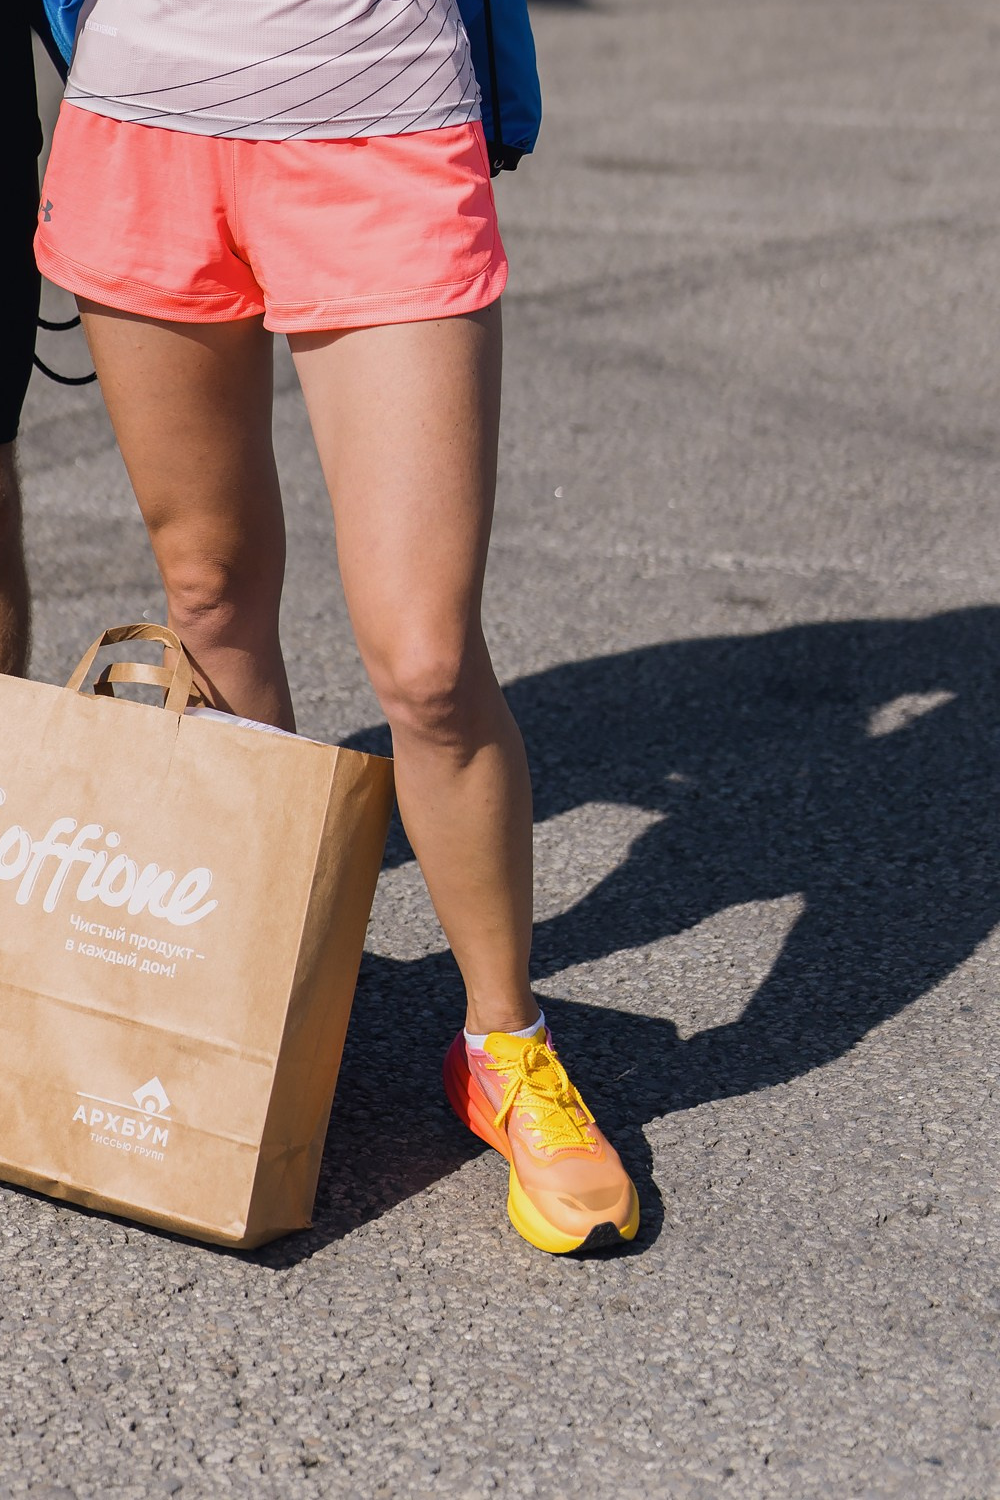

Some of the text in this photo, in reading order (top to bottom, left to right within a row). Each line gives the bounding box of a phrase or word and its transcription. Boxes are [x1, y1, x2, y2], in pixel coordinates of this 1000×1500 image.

[70, 914, 126, 942] Чистый
[128, 933, 194, 959] продукт
[64, 939, 177, 978] в каждый дом!
[72, 1105, 169, 1148] АРХБУМ
[90, 1132, 165, 1161] ТИССЬЮ ГРУПП
